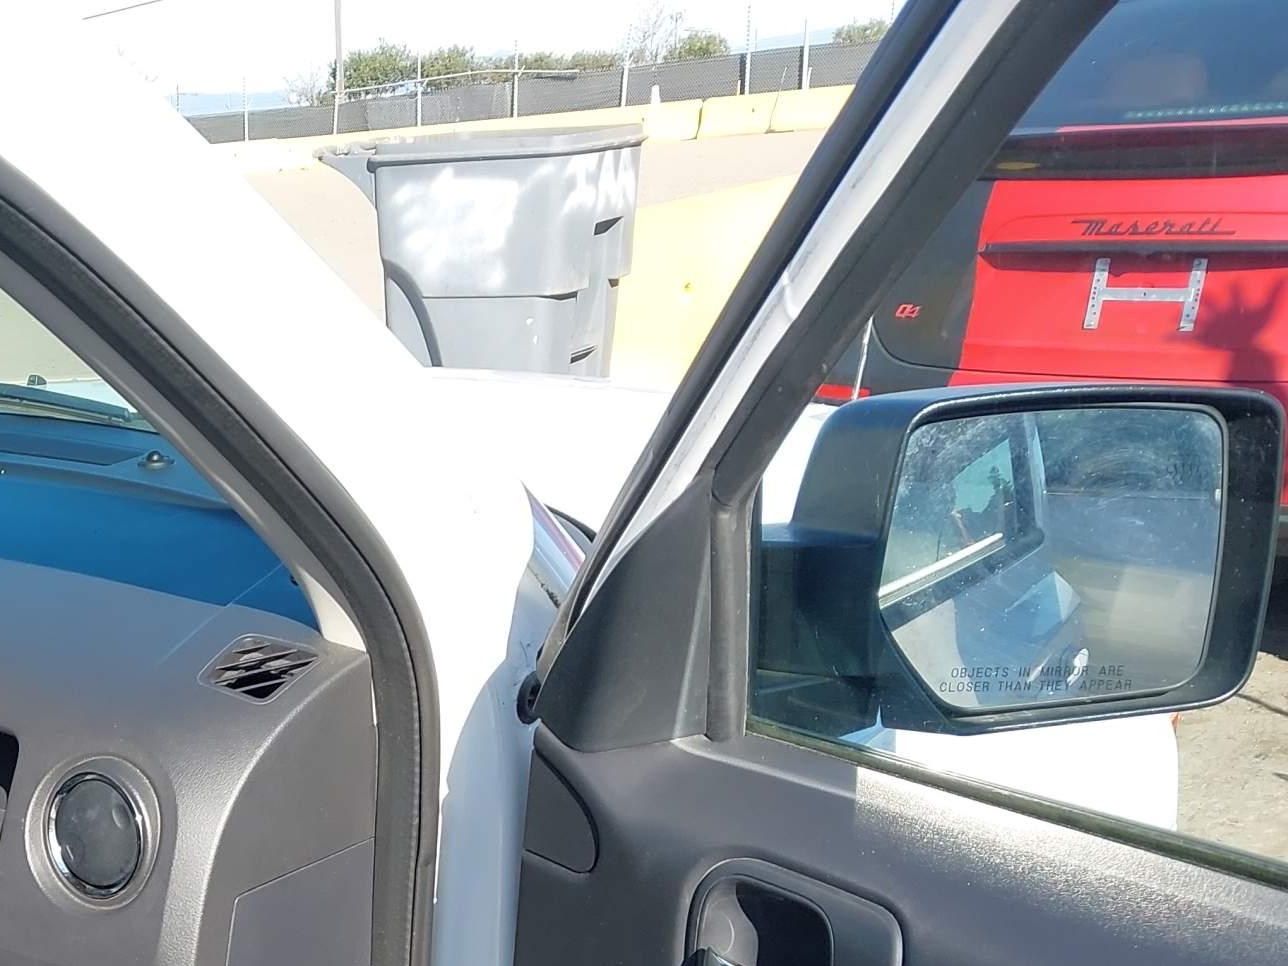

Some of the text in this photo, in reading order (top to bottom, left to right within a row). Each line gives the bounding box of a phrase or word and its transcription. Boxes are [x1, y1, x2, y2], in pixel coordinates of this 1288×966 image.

[1071, 217, 1237, 236] Maserati
[950, 664, 1126, 679] OBJECTS IN MIRROR ARE
[939, 679, 1133, 693] CLOSER THAN THEY APPEAR
